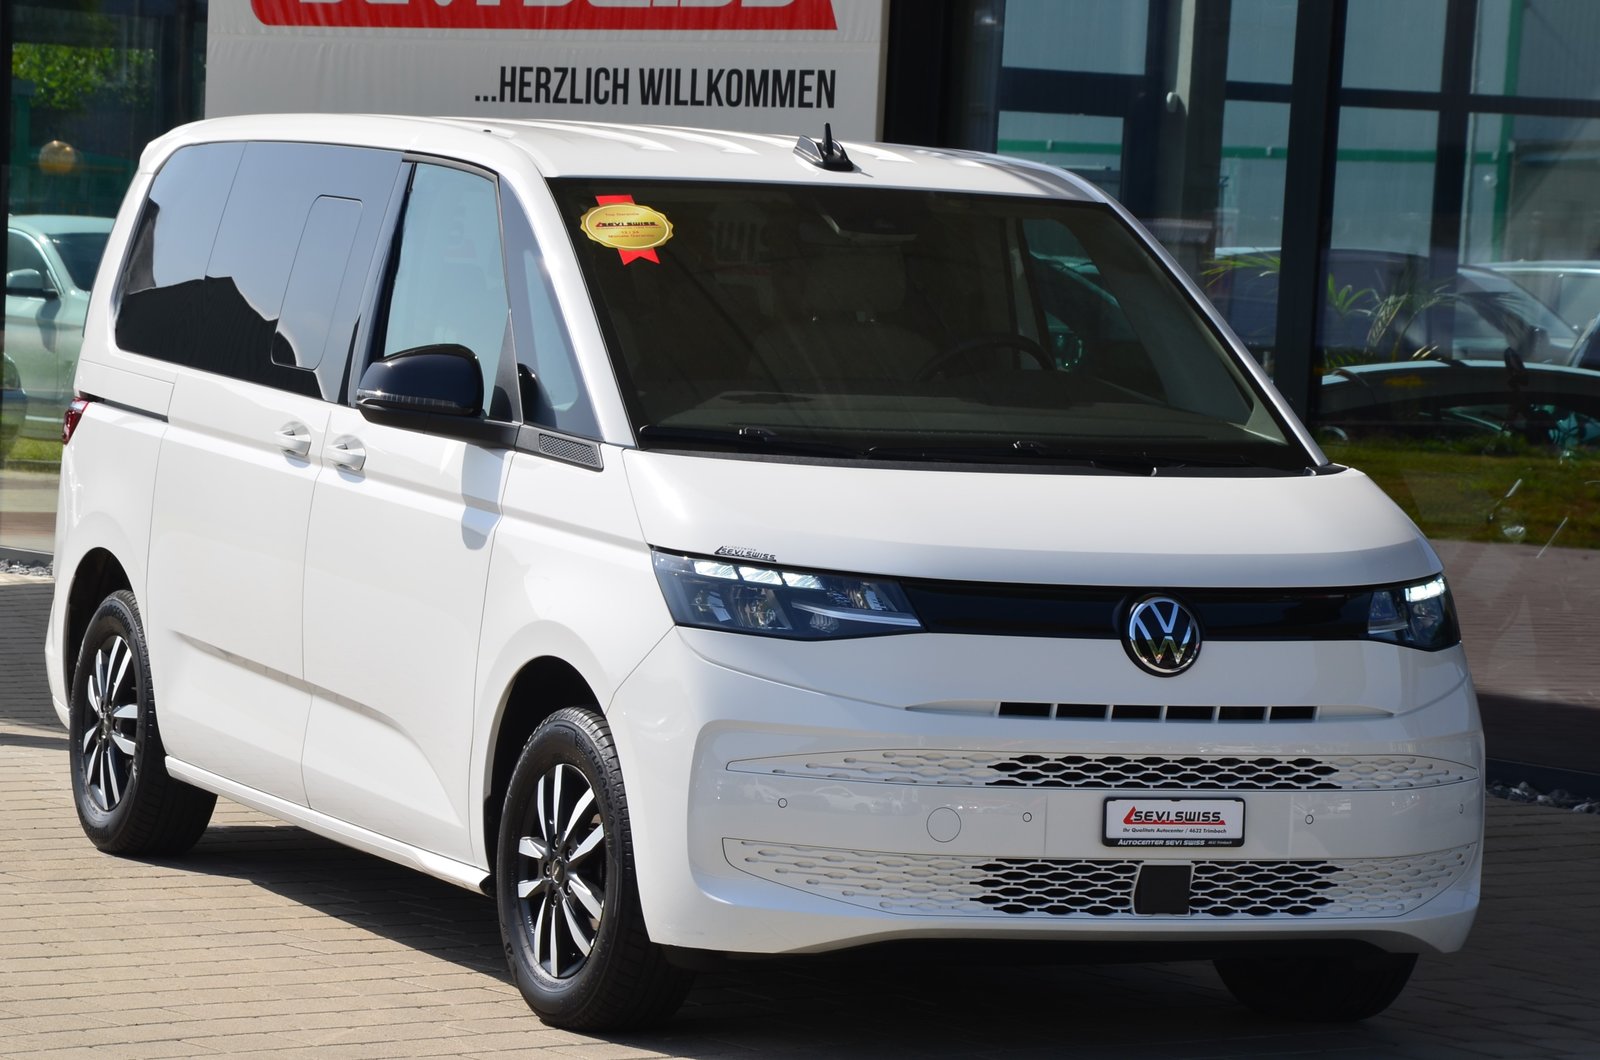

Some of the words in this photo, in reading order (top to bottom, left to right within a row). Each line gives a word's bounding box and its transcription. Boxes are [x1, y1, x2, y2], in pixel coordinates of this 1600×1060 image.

[474, 66, 630, 105] ...HERZLICH
[638, 67, 836, 108] WILLKOMMEN
[1132, 810, 1171, 822] SEVI
[1174, 811, 1222, 823] SWISS
